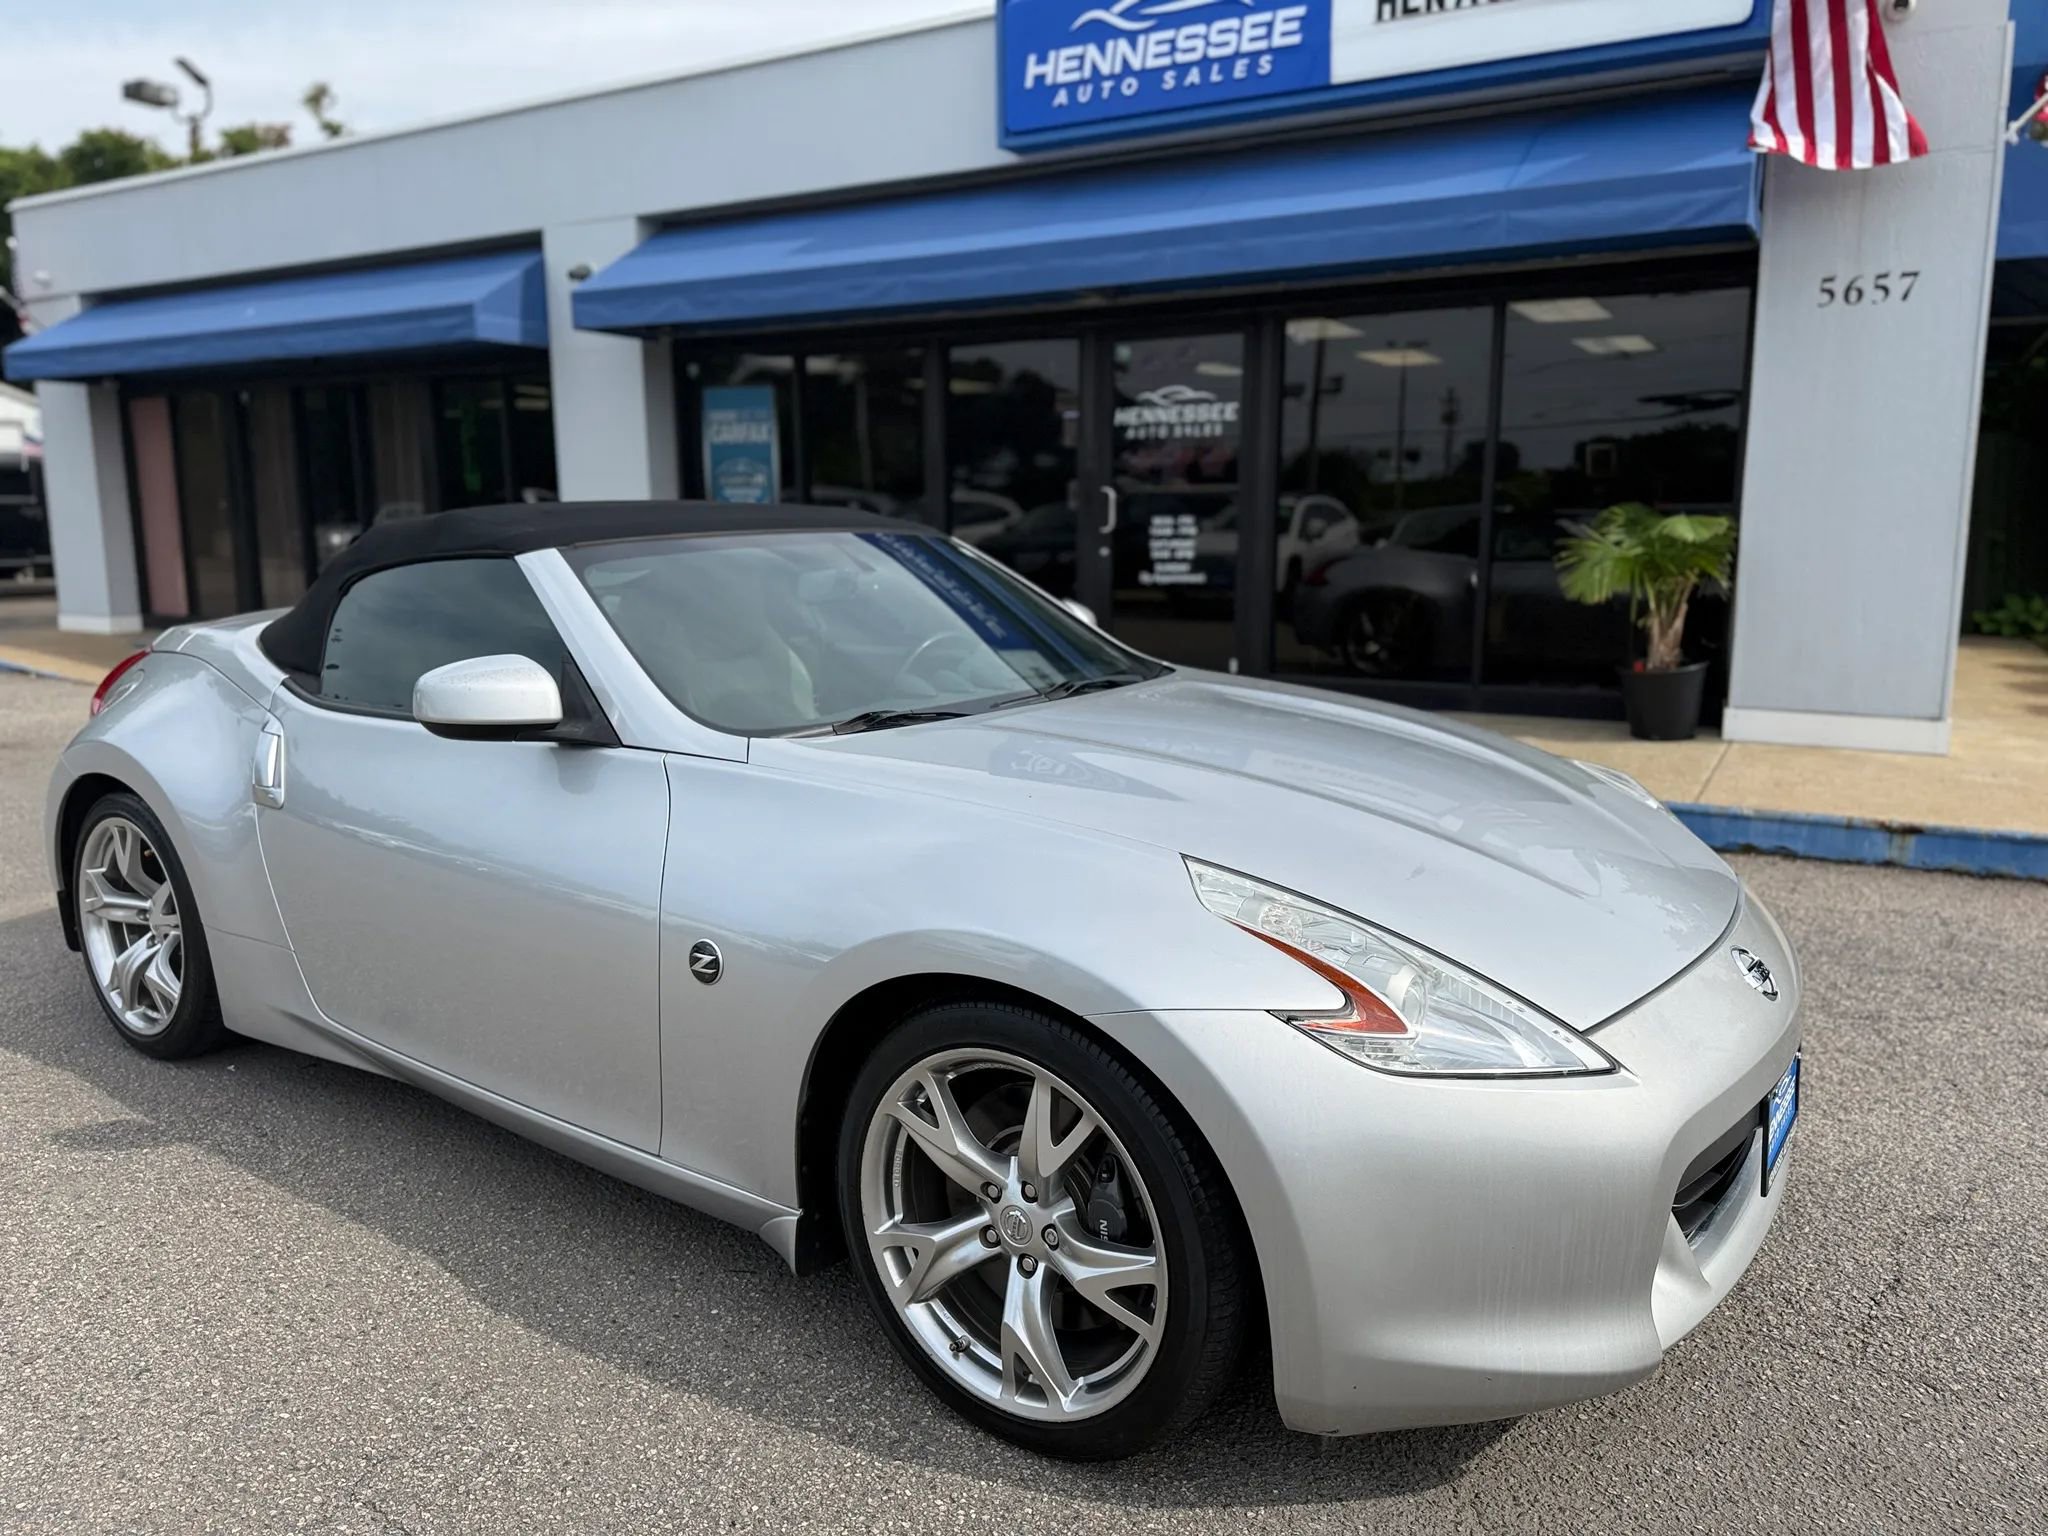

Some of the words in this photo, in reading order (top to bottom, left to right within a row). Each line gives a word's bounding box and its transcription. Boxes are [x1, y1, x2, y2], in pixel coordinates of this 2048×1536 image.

[1024, 5, 1308, 89] HENNESSEE
[1052, 76, 1139, 107] AUTO
[1161, 54, 1273, 90] SALES
[1816, 270, 1921, 308] 5657
[1113, 401, 1240, 427] HENNESSEE
[690, 952, 717, 974] Z
